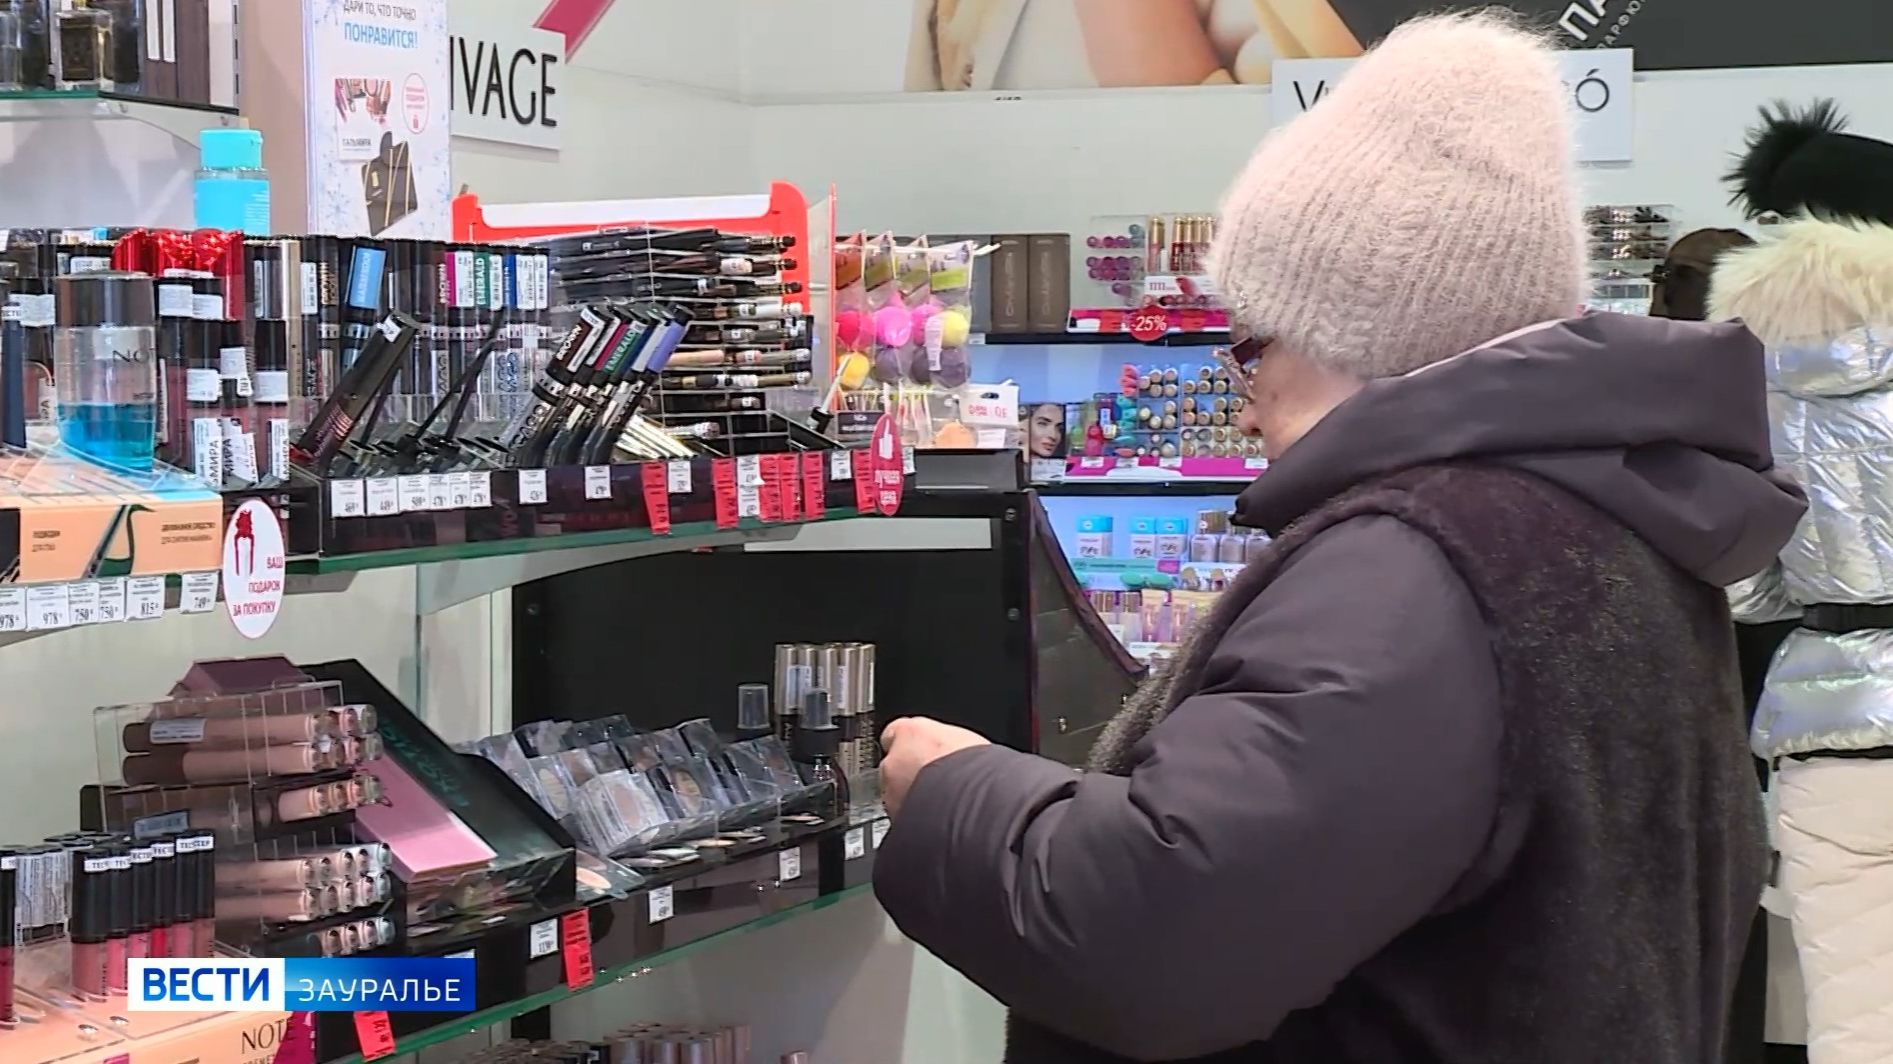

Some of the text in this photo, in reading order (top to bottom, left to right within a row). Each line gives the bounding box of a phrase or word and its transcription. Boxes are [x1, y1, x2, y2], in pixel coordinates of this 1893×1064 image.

[1597, 0, 1645, 48] АРФЮ
[344, 22, 419, 48] ПОНРАВИТСЯ!
[1131, 315, 1168, 331] -25%
[555, 323, 583, 361] BROWN
[603, 329, 637, 372] EMERALD
[266, 556, 283, 568] ВАШ
[248, 580, 280, 593] ПОДАРОК
[232, 604, 242, 616] ЗА
